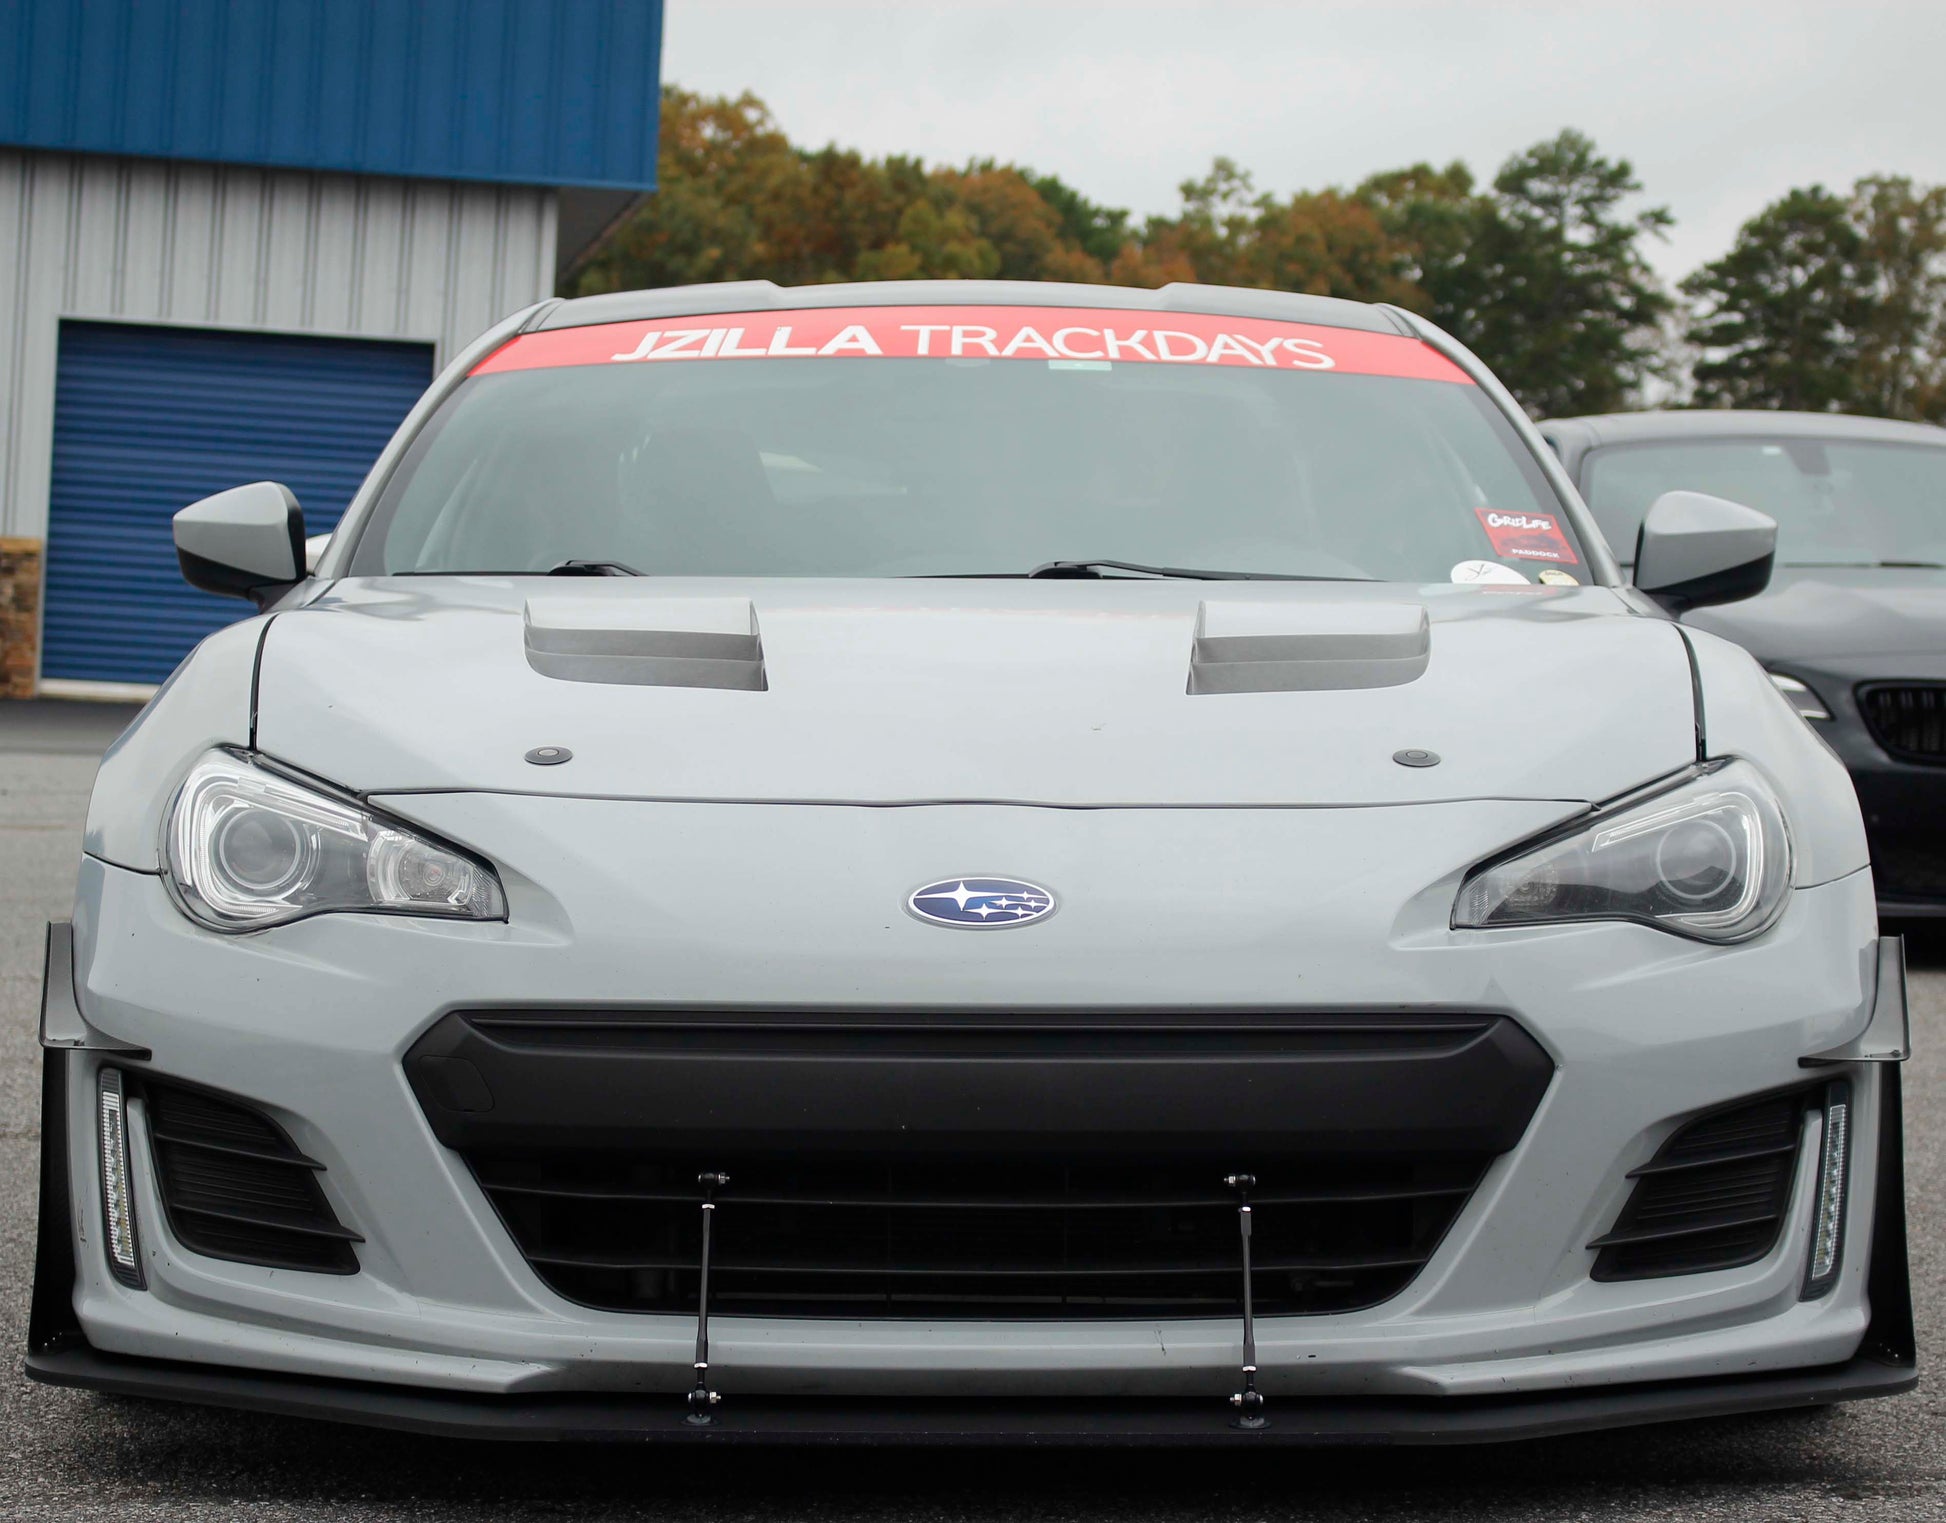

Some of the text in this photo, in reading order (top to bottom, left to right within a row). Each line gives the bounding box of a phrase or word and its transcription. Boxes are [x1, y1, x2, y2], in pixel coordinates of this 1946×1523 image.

[610, 324, 1336, 370] JZILLA TRACKDAYS
[1511, 548, 1560, 558] PADDOCK
